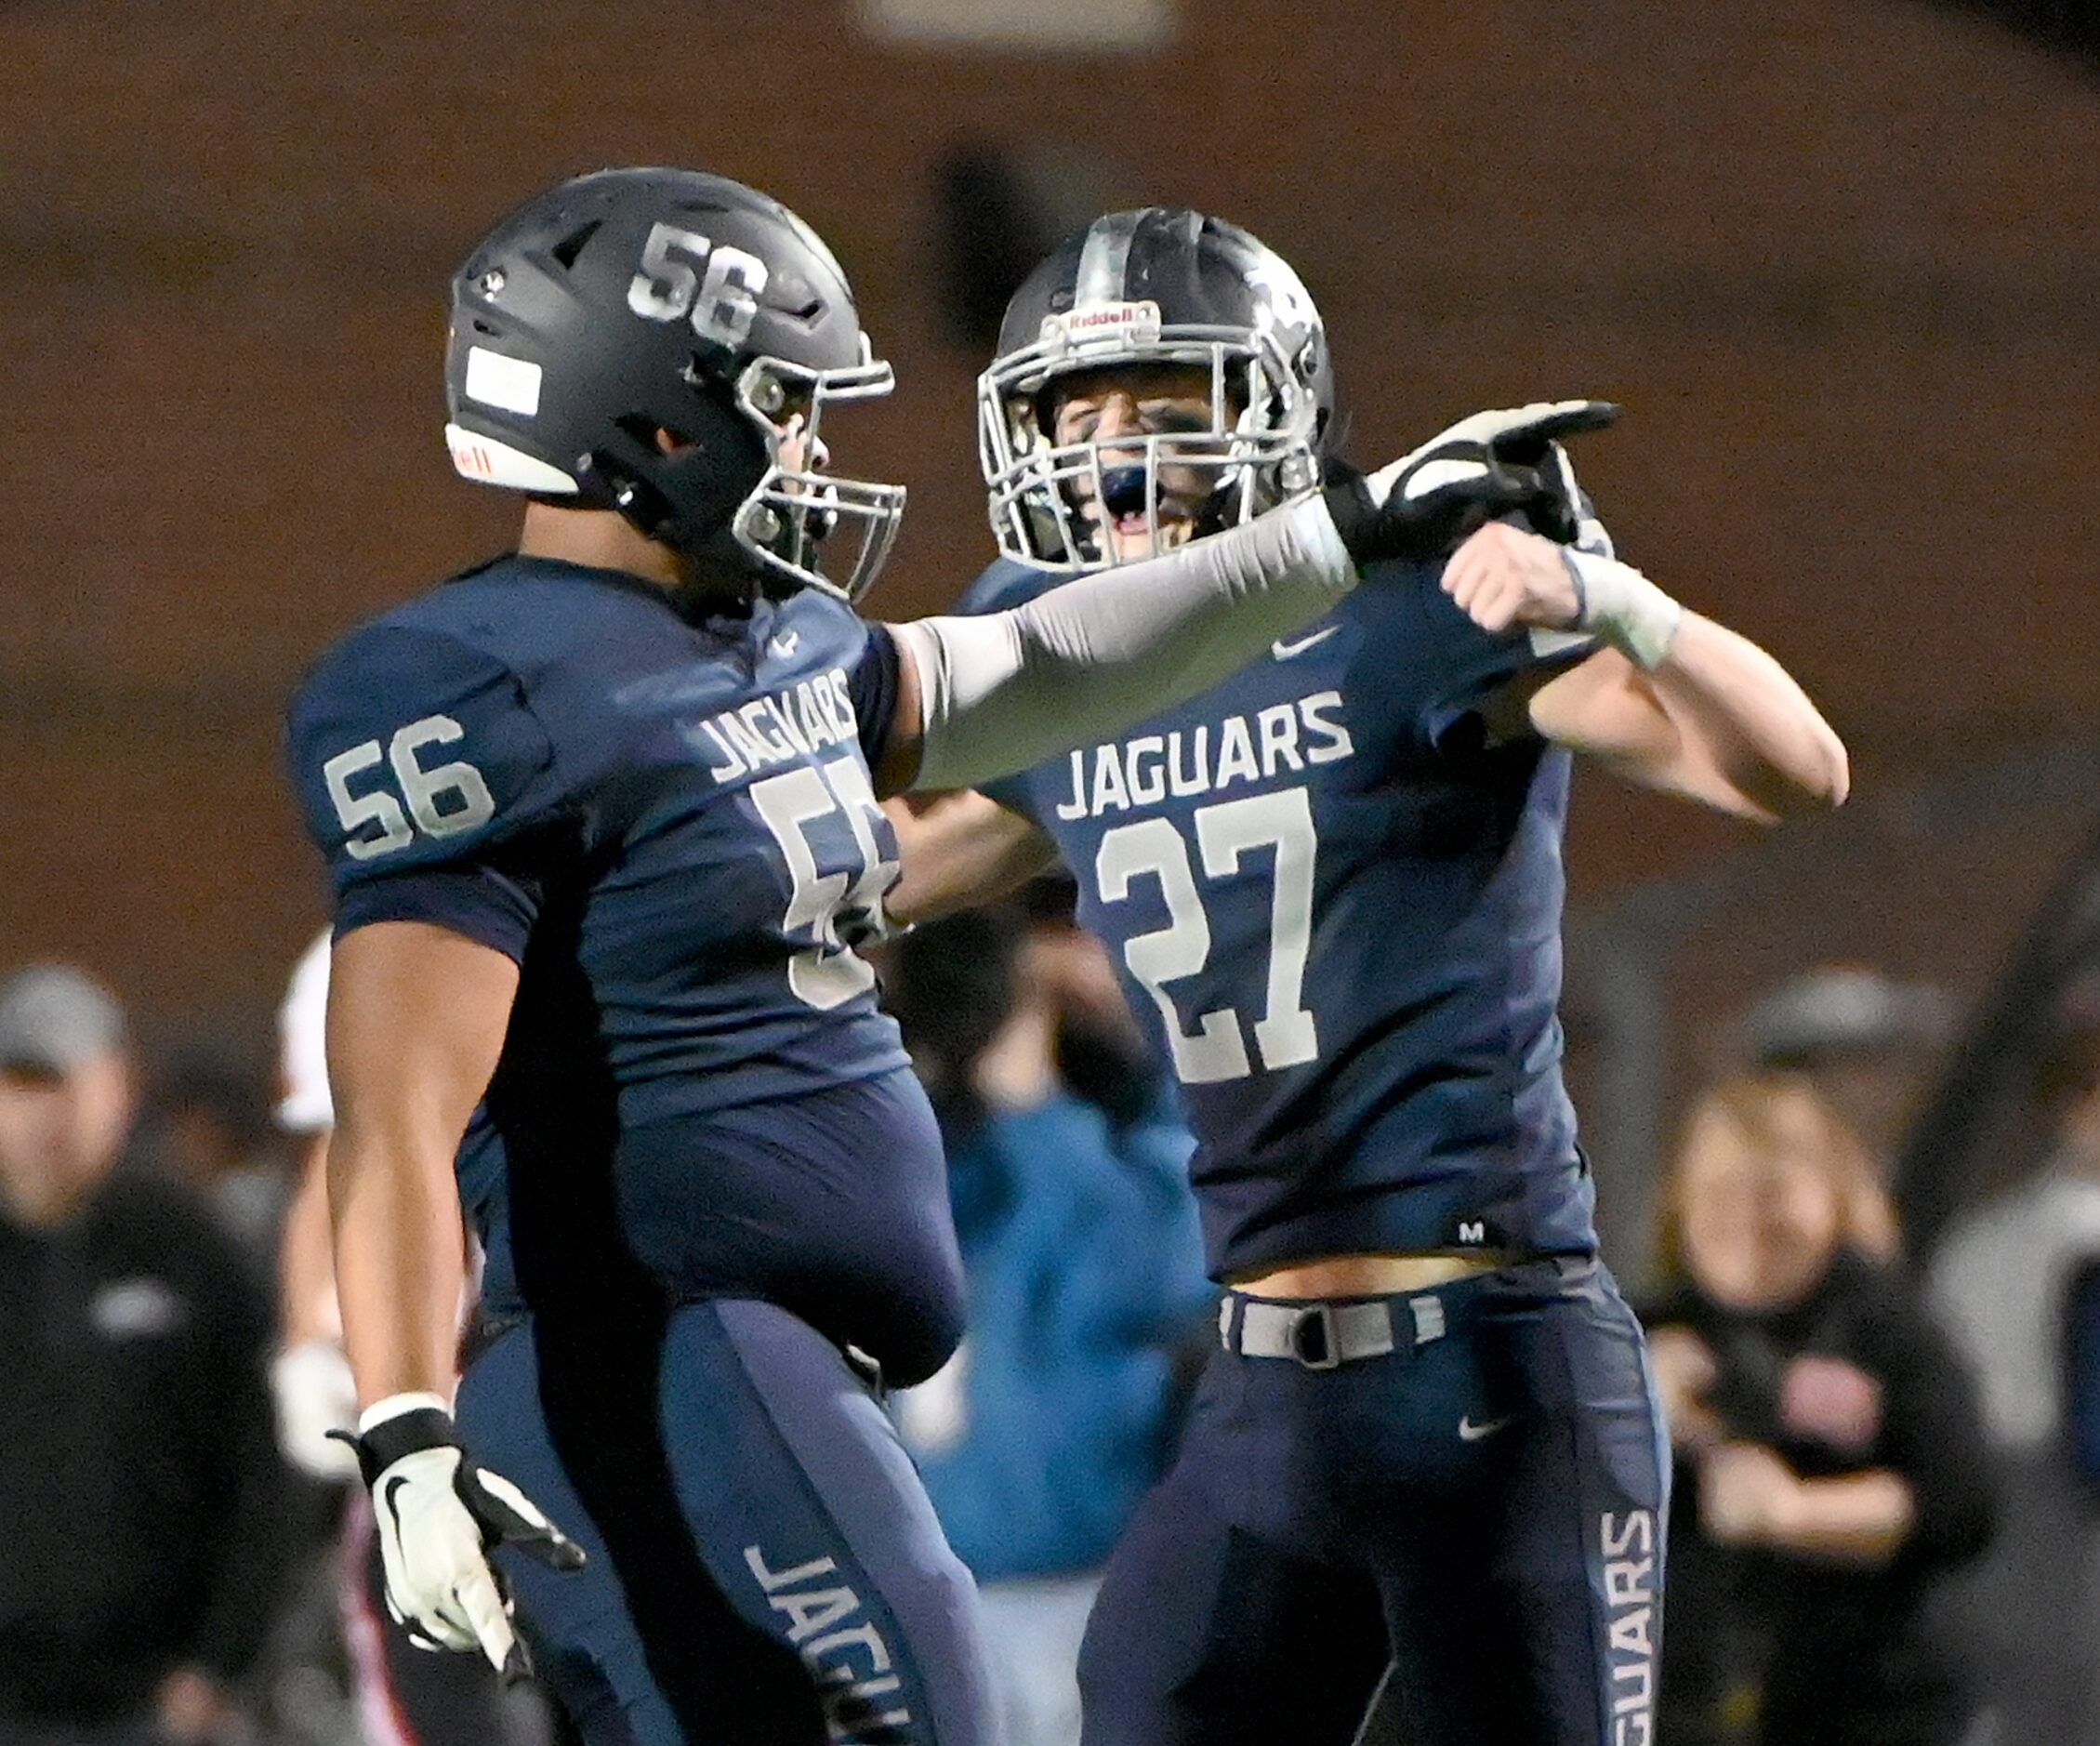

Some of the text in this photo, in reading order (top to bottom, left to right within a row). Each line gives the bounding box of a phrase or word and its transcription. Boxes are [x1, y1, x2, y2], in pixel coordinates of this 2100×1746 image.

[627, 221, 769, 350] 56
[1070, 309, 1132, 329] Riddell
[324, 714, 495, 860] 56
[700, 668, 858, 784] JAGUARS
[1056, 690, 1355, 820] JAGUARS
[1096, 786, 1318, 1084] 27
[1459, 1222, 1485, 1243] M
